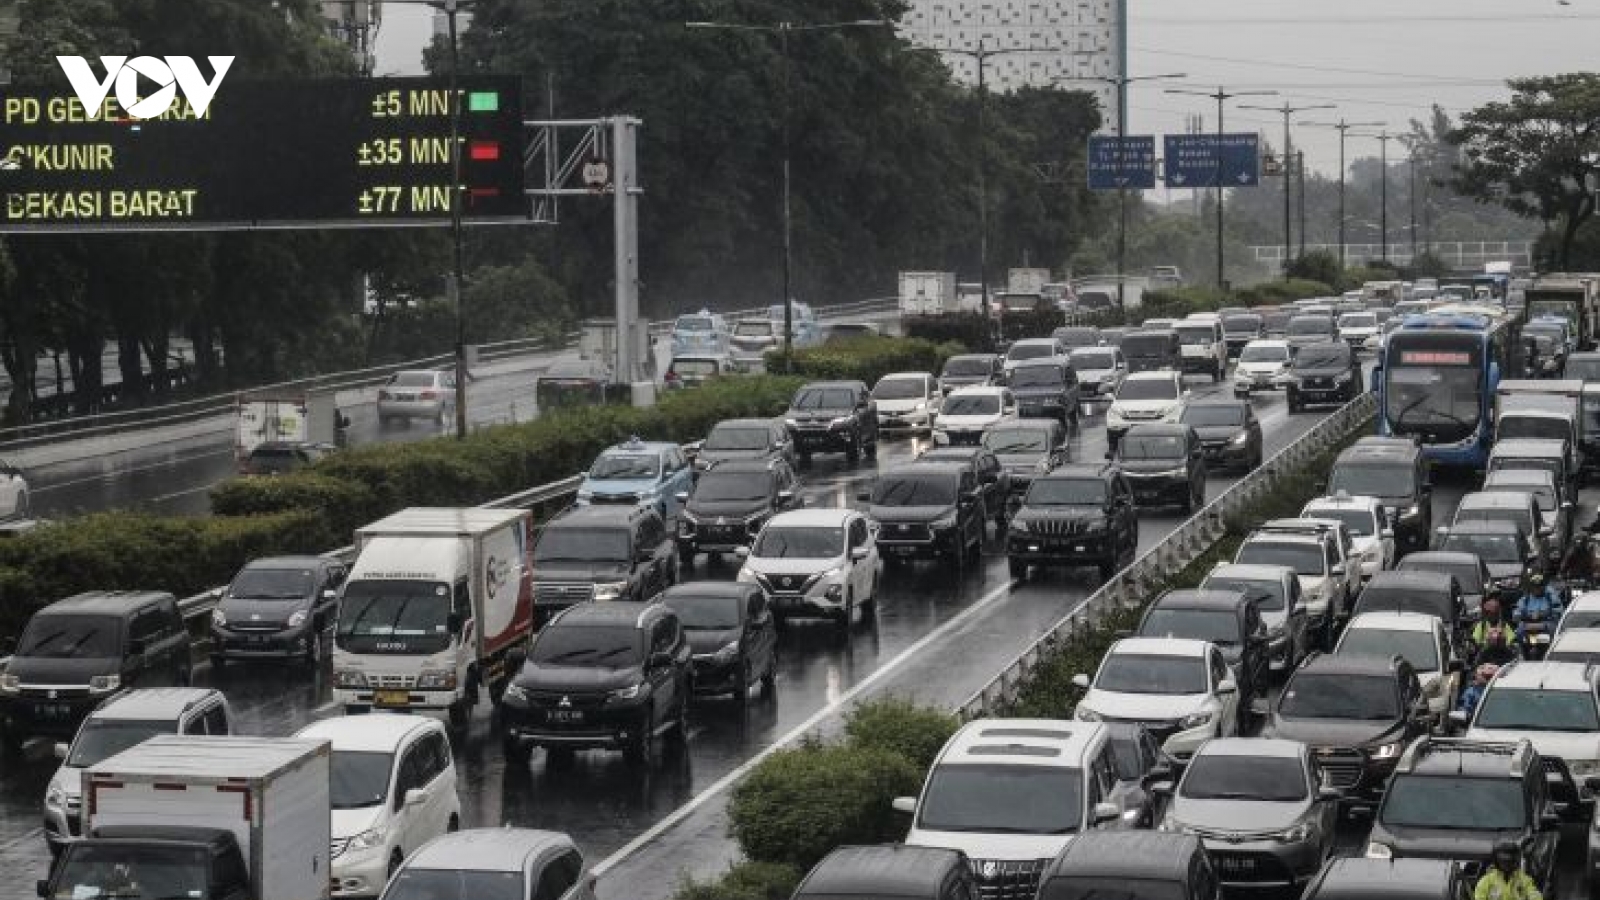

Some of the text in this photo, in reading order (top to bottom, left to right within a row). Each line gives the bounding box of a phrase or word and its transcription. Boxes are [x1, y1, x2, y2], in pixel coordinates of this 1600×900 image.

[6, 98, 40, 123] PD
[128, 96, 215, 121] RAT
[372, 90, 401, 117] ±5
[359, 138, 402, 165] ±35
[8, 190, 197, 219] BEKASI BARAT
[359, 186, 402, 213] ±77
